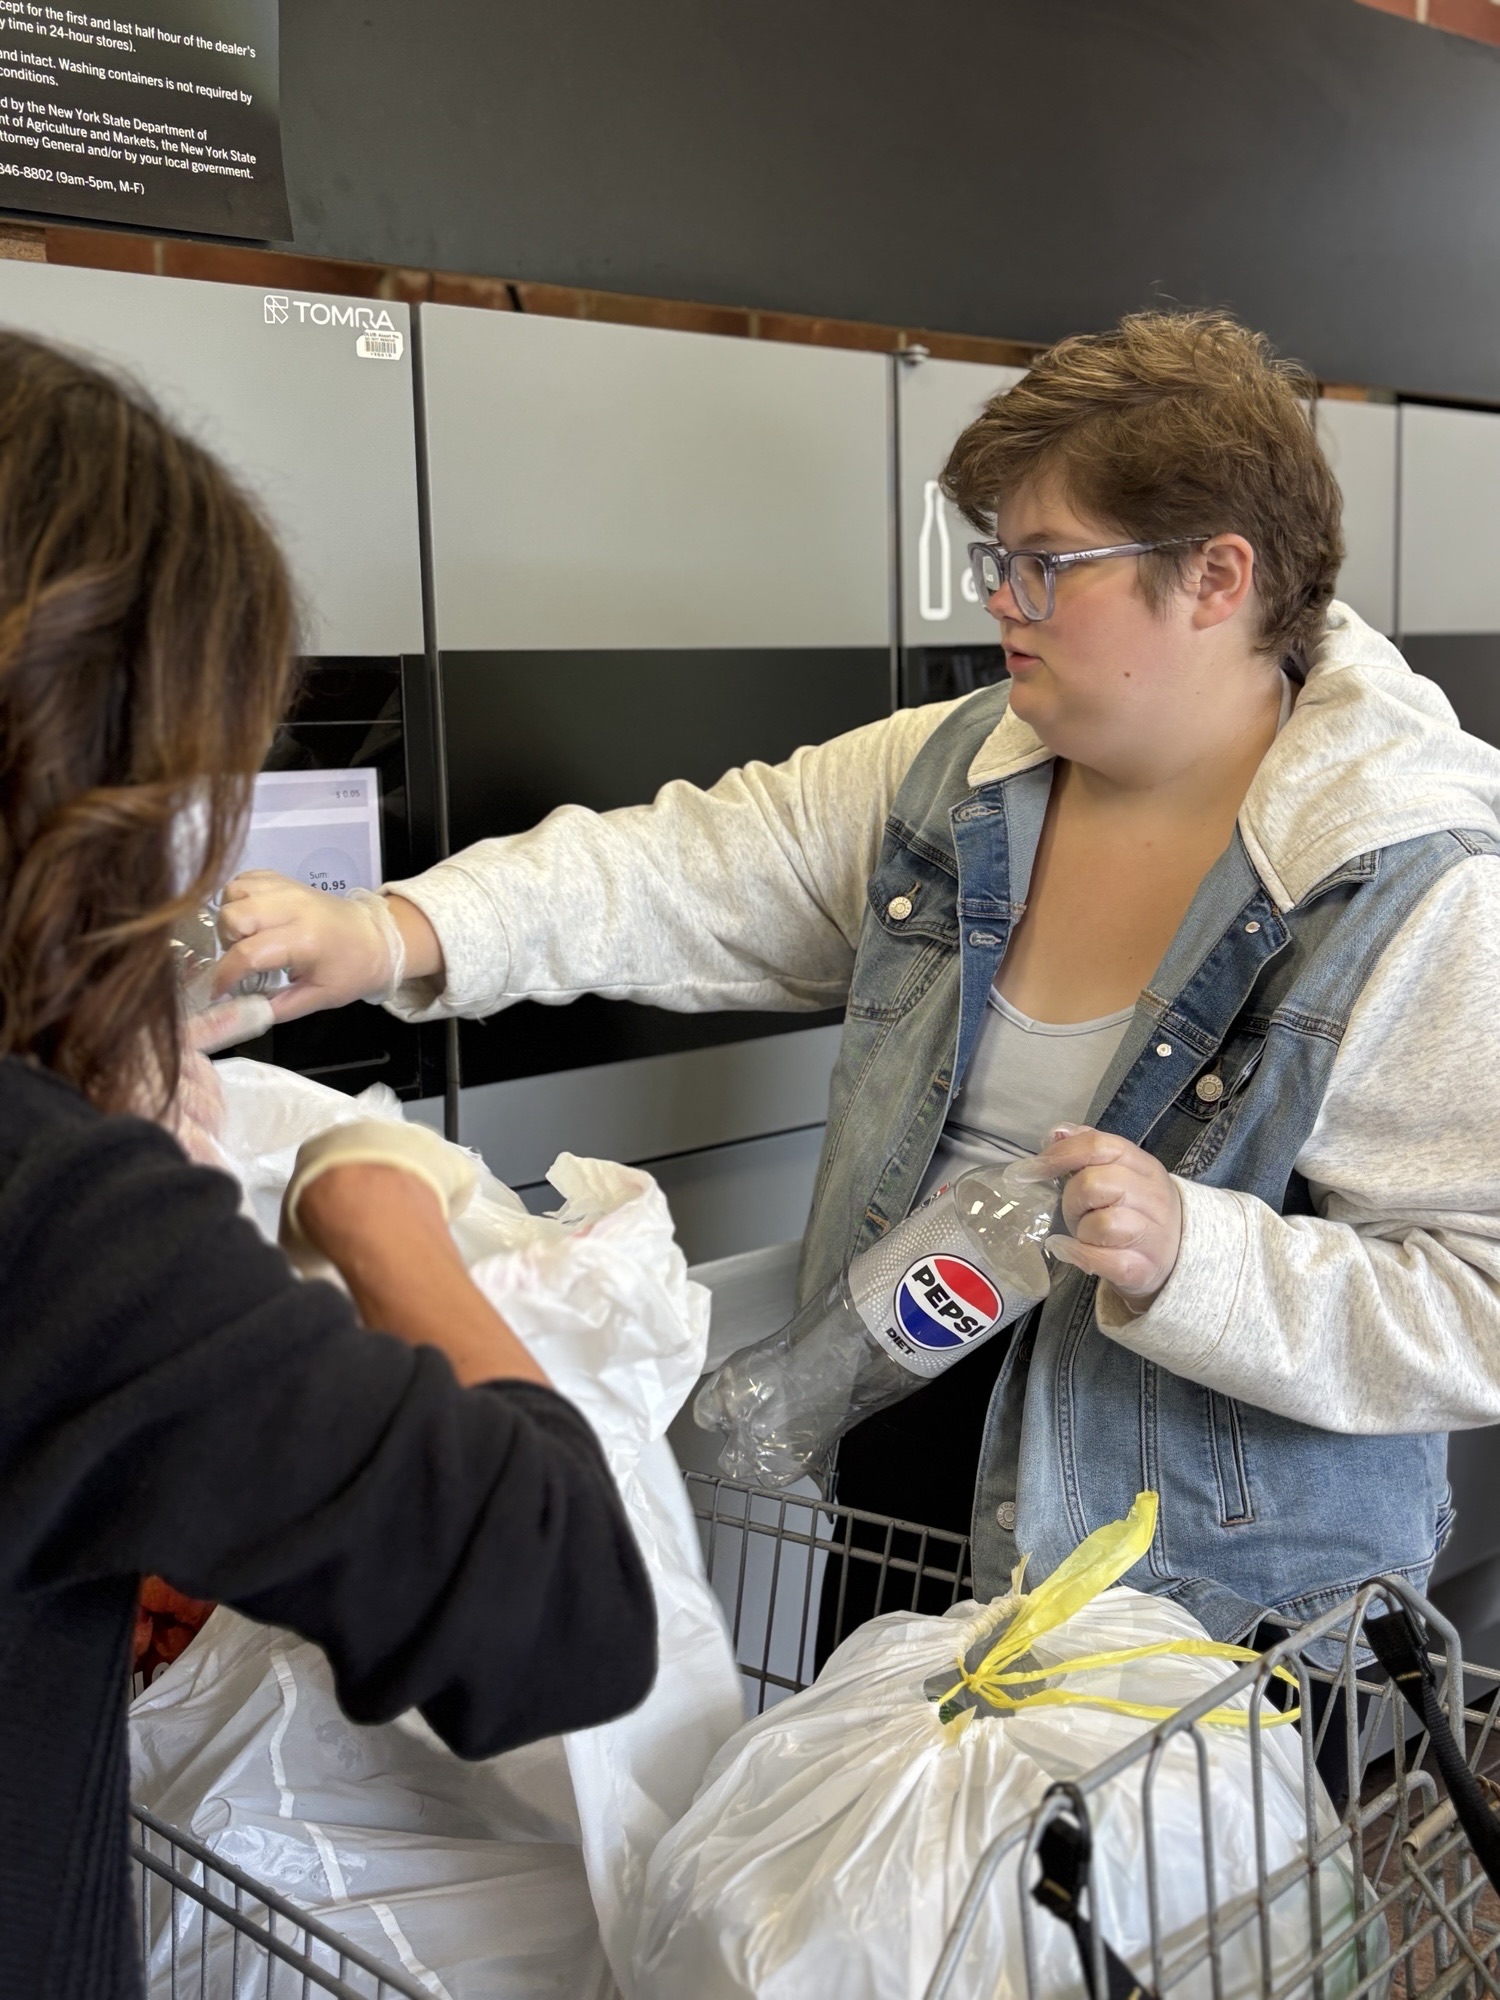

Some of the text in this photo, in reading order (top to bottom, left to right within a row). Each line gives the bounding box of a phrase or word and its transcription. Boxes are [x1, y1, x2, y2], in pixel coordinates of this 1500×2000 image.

[8, 17, 34, 33] time
[36, 22, 47, 35] in
[49, 24, 94, 44] 24-hour
[96, 35, 136, 52] stores).
[26, 3, 43, 17] for
[45, 6, 64, 21] the
[66, 10, 88, 26] first
[90, 18, 111, 31] and
[113, 19, 133, 35] last
[135, 24, 155, 39] half
[157, 28, 182, 44] hour
[183, 34, 194, 47] of
[196, 36, 213, 50] the
[215, 40, 256, 58] dealer's
[20, 50, 56, 69] intact.
[58, 57, 106, 80] Washing
[107, 69, 164, 88] containers
[165, 77, 175, 90] is
[176, 82, 194, 94] not
[195, 85, 238, 101] required
[240, 90, 252, 106] by
[10, 97, 25, 113] by
[26, 101, 46, 115] the
[48, 103, 73, 119] New
[75, 108, 101, 124] York
[102, 113, 131, 129] State
[133, 118, 195, 139] Department
[197, 129, 207, 141] of
[12, 115, 23, 128] of
[26, 117, 88, 138] Agriculture
[90, 129, 111, 142] and
[112, 130, 159, 151] Markets,
[161, 139, 179, 152] the
[180, 141, 204, 156] New
[205, 145, 229, 160] York
[230, 149, 257, 164] State
[41, 136, 85, 154] General
[87, 145, 122, 159] and/or
[124, 149, 138, 164] by
[139, 154, 163, 165] your
[164, 155, 190, 170] local
[191, 162, 254, 179] government.
[56, 171, 117, 192] (9am-5pm,
[119, 180, 145, 195] M-F)
[293, 301, 395, 331] TOMRA
[321, 880, 346, 891] 0.95
[912, 1265, 986, 1337] PEPSI
[885, 1327, 916, 1356] DIET
